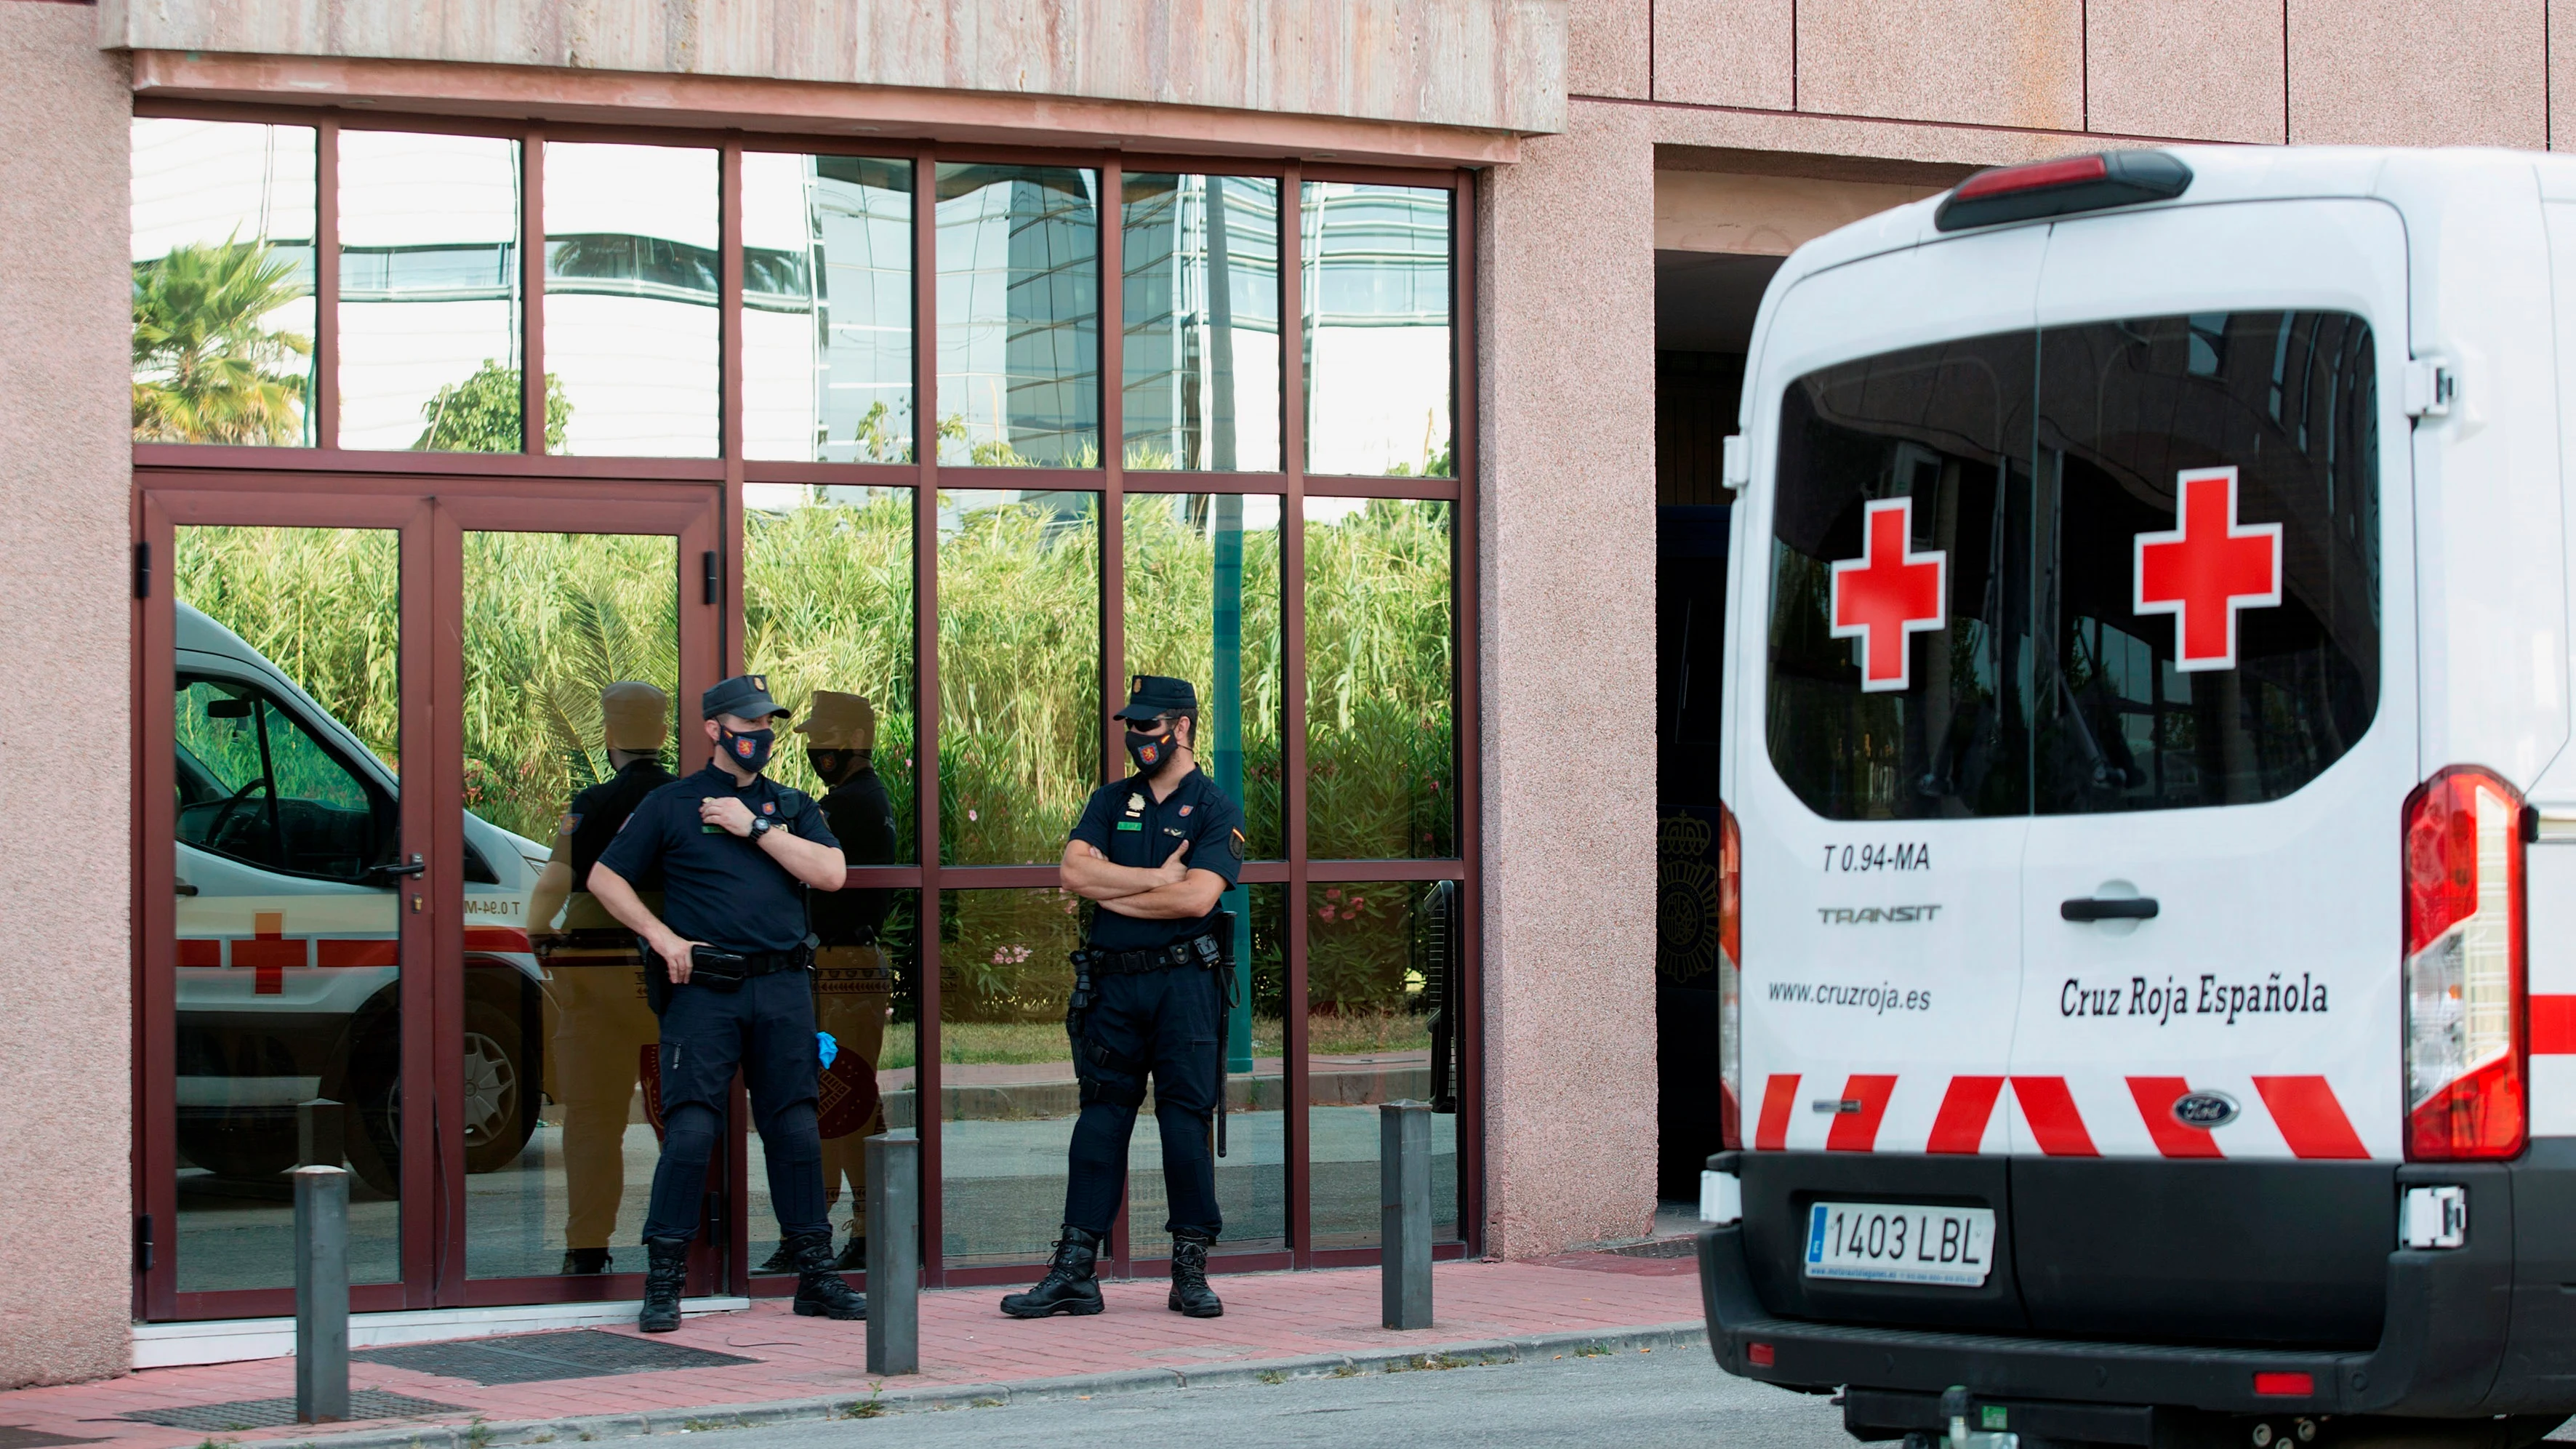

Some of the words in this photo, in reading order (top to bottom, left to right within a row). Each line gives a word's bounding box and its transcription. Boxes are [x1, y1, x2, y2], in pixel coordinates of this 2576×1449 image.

[1824, 845, 1837, 872] T
[1841, 842, 1930, 872] 0.94-MA
[1818, 904, 1942, 924] TRANSIT
[1769, 980, 1932, 1016] www.cruzroja.es
[2061, 978, 2122, 1016] Cruz
[2128, 975, 2188, 1026] Roja
[2196, 971, 2328, 1024] Española
[2183, 1098, 2222, 1120] Ford
[1835, 1212, 1908, 1260] 1403
[1917, 1216, 1980, 1265] LBL
